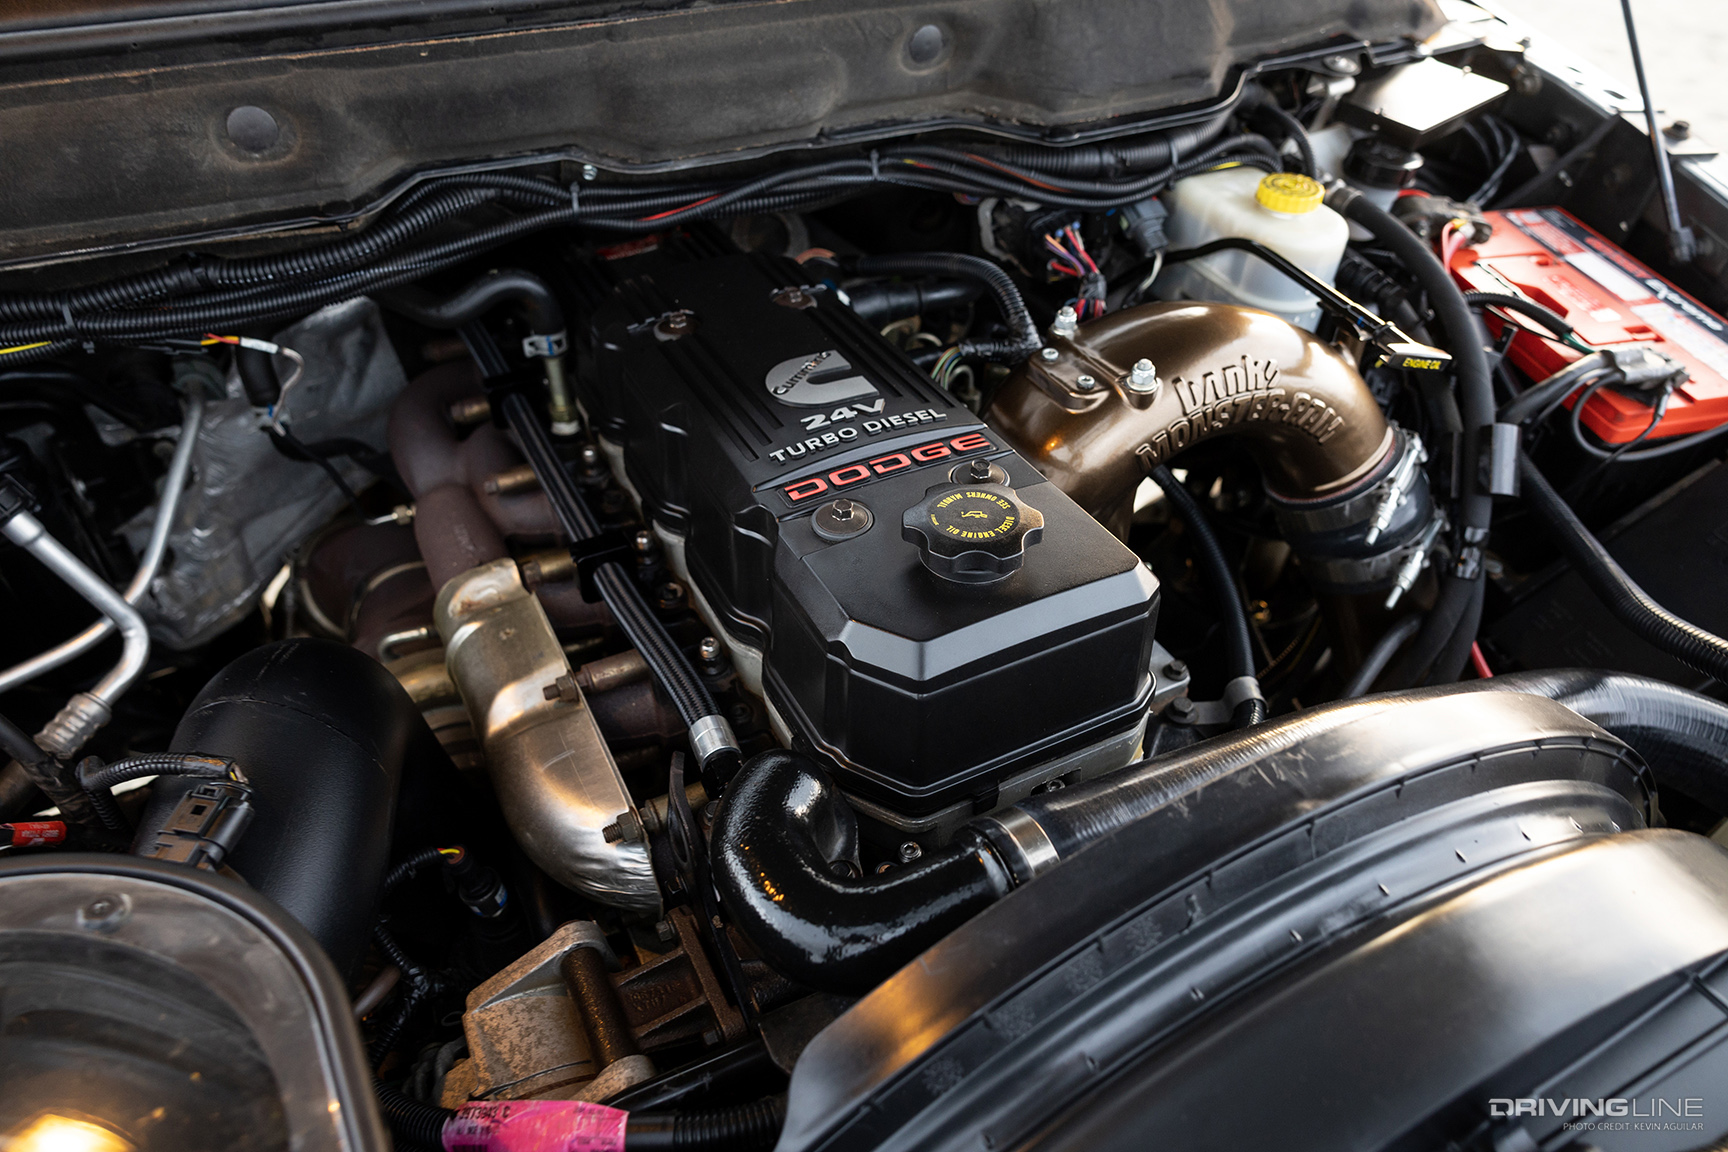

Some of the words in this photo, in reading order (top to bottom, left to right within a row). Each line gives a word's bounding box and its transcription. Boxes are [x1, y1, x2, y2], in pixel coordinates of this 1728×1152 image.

[1402, 357, 1430, 369] ENGINE
[1430, 359, 1442, 370] OIL
[771, 351, 832, 395] Cummins
[800, 398, 886, 434] 24V
[769, 427, 858, 465] TURBO
[862, 408, 947, 436] DIESEL
[784, 433, 991, 501] DODGE
[936, 493, 963, 508] MANUAL
[966, 491, 998, 501] OWNERS
[996, 499, 1011, 510] SEE
[946, 525, 960, 535] OIL
[994, 516, 1016, 534] DIESEL
[960, 530, 996, 539] ENGINE
